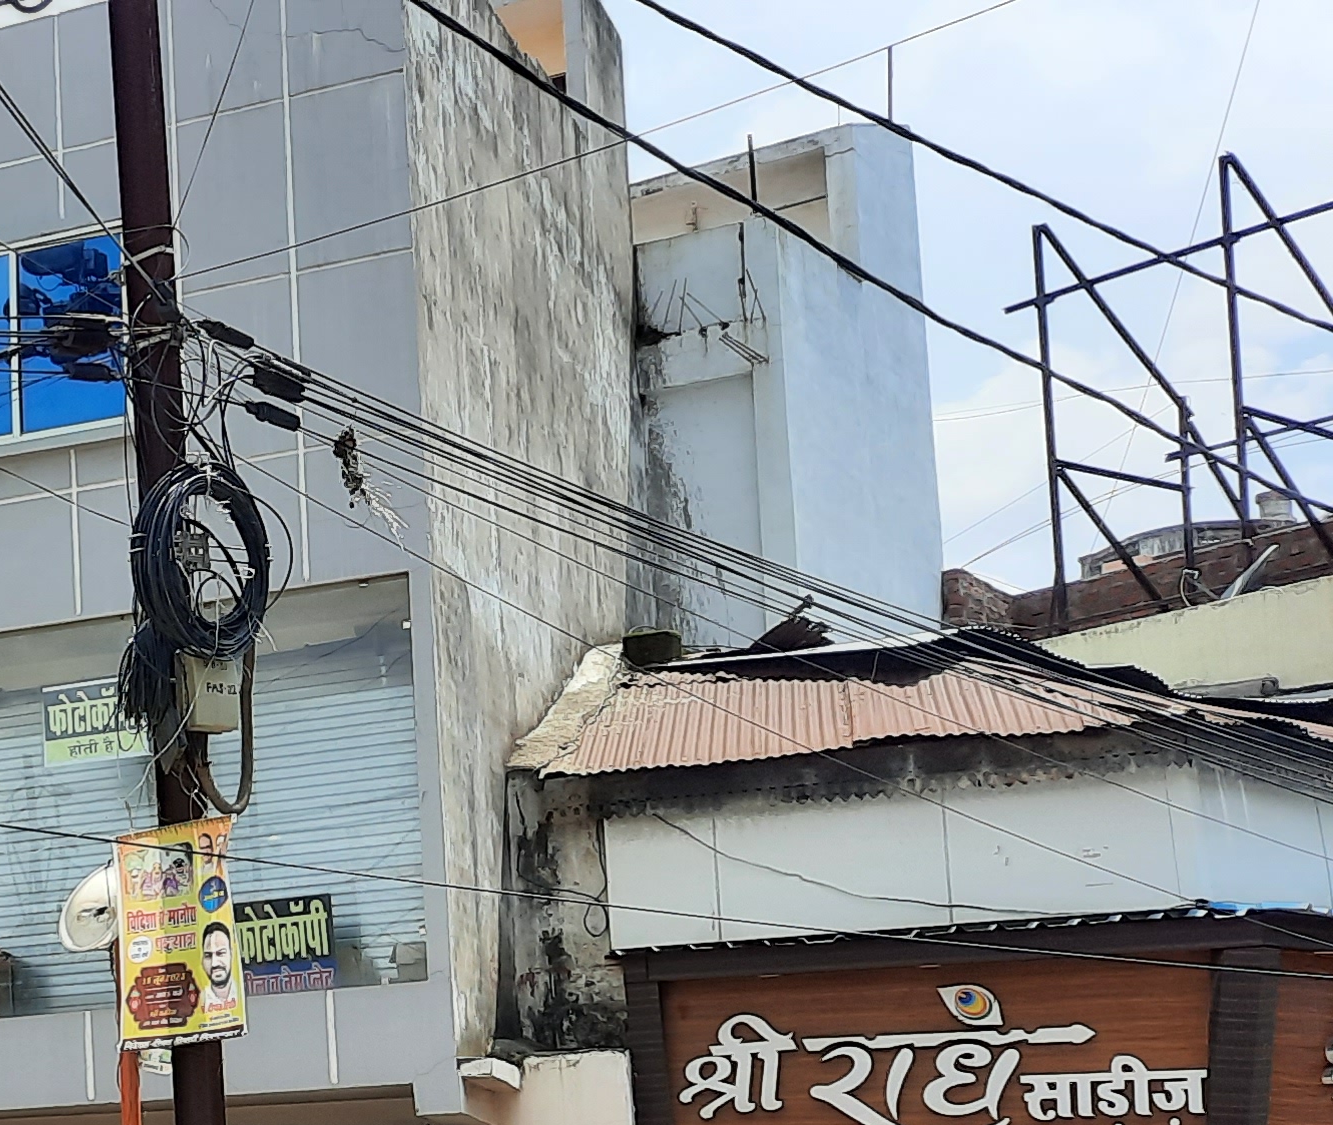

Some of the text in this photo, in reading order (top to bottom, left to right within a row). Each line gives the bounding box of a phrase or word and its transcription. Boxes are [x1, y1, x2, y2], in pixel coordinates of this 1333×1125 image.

[67, 740, 99, 757] होती
[236, 899, 330, 965] फोटोकॉपी
[678, 1012, 799, 1120] श्री
